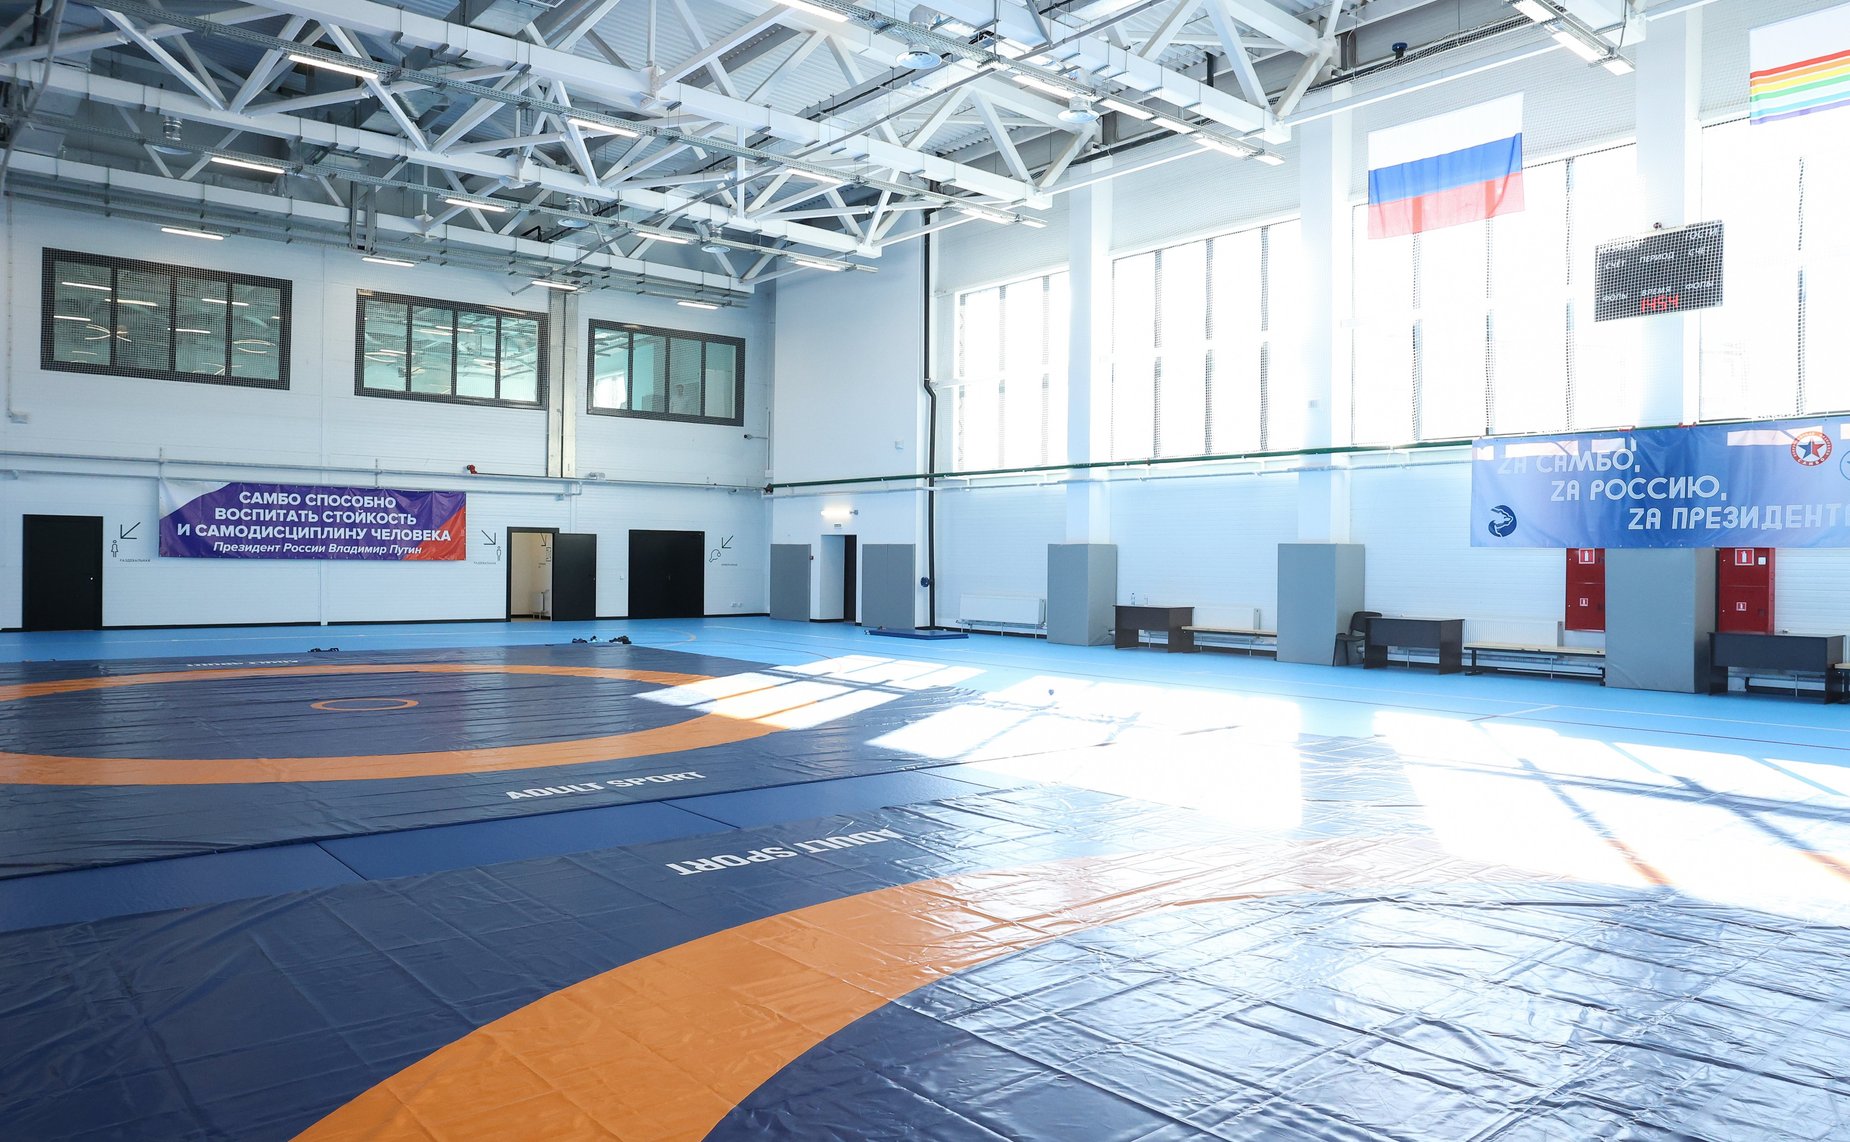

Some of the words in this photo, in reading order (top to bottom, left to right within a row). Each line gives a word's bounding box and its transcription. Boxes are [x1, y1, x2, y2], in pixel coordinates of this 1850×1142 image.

[1640, 251, 1675, 263] ПЕРИОД
[1641, 286, 1672, 297] ВРЕМЯ
[1589, 475, 1727, 501] РОССИЮ,
[239, 491, 301, 505] САМБО
[305, 494, 397, 508] СПОСОБНО
[215, 507, 318, 523] ВОСПИТАТЬ
[322, 510, 417, 525] СТОЙКОСТЬ
[177, 523, 190, 536] И
[195, 524, 366, 540] САМОДИСЦИПЛИНУ
[371, 529, 451, 542] ЧЕЛОВЕКА
[213, 541, 281, 553] Президент
[283, 543, 326, 553] России
[328, 543, 387, 555] Владимир
[389, 545, 422, 556] Путин
[505, 782, 605, 800] ADULT
[606, 771, 707, 788] SPORT
[793, 828, 906, 854] ADULT
[665, 846, 798, 876] SPORT
